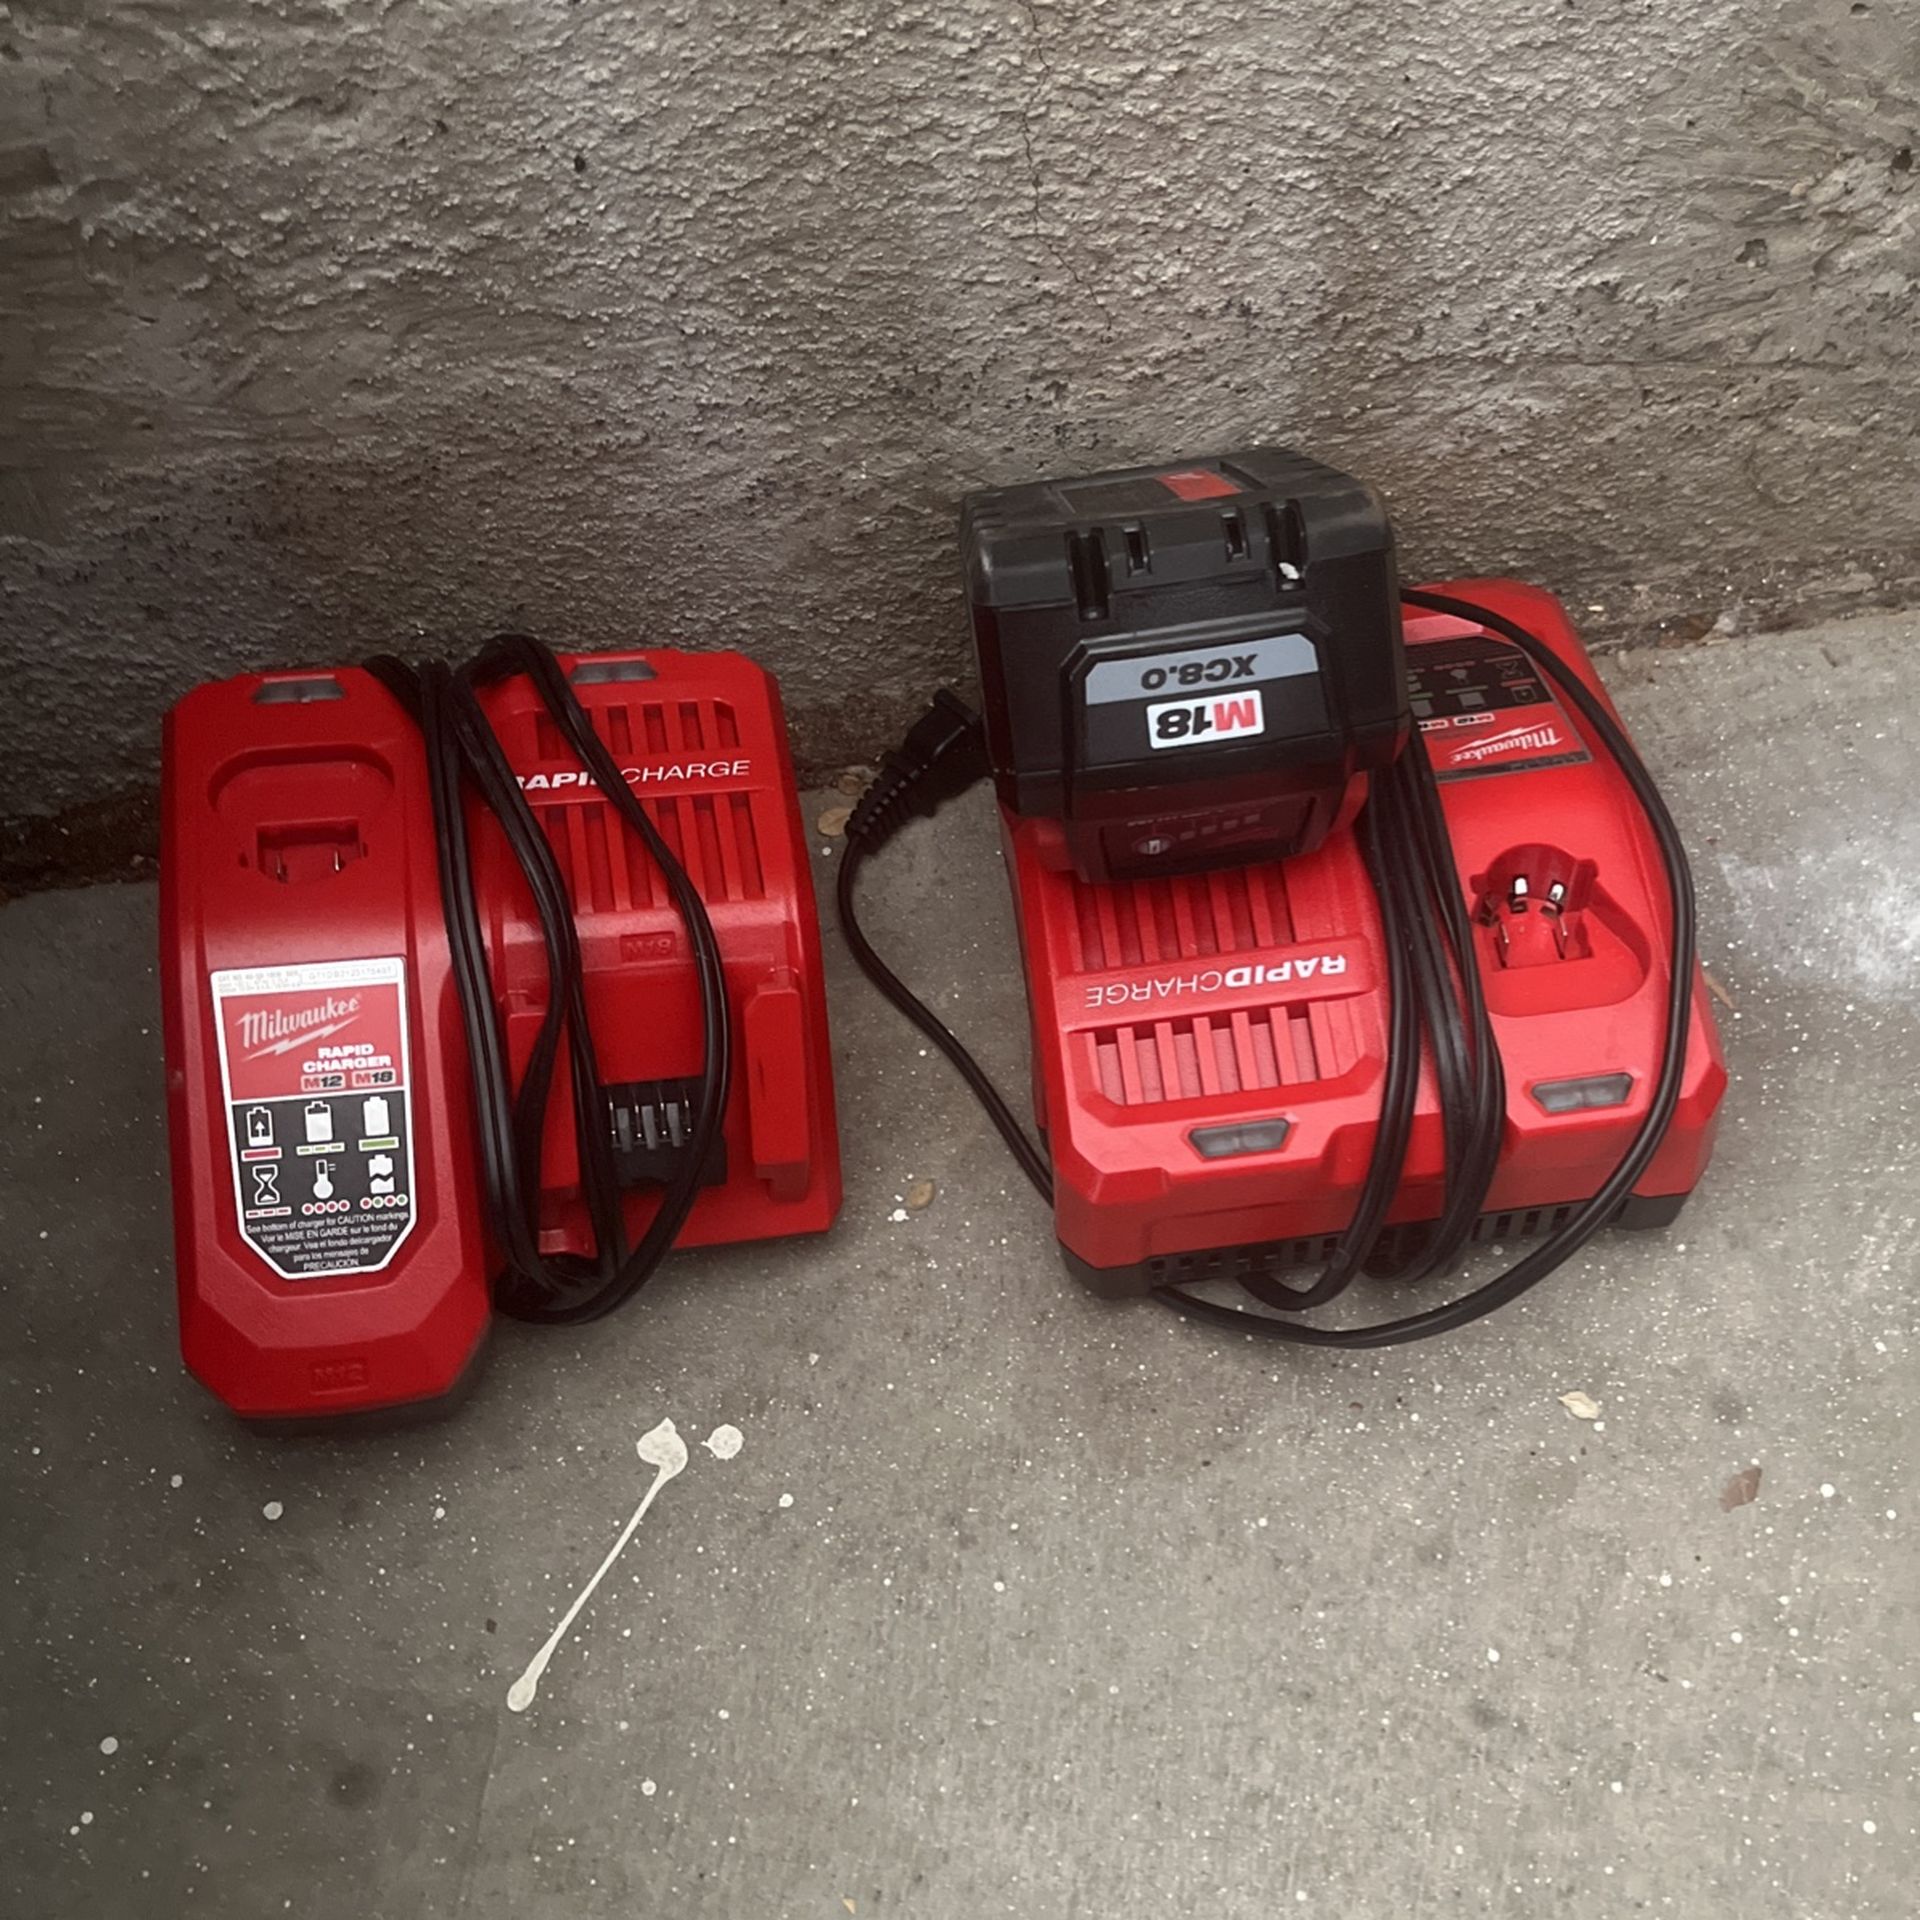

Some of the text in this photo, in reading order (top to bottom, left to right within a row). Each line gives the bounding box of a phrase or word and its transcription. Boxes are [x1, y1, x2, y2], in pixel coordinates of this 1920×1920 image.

[1140, 653, 1258, 690] XC8.0
[1156, 698, 1256, 740] M18
[1451, 727, 1564, 764] Milwaukee
[235, 996, 359, 1048] Milwaukee
[302, 1055, 392, 1073] CHARGER
[317, 1043, 374, 1059] RAPID
[303, 1070, 393, 1089] M12 M18
[337, 1213, 375, 1225] CAUTION
